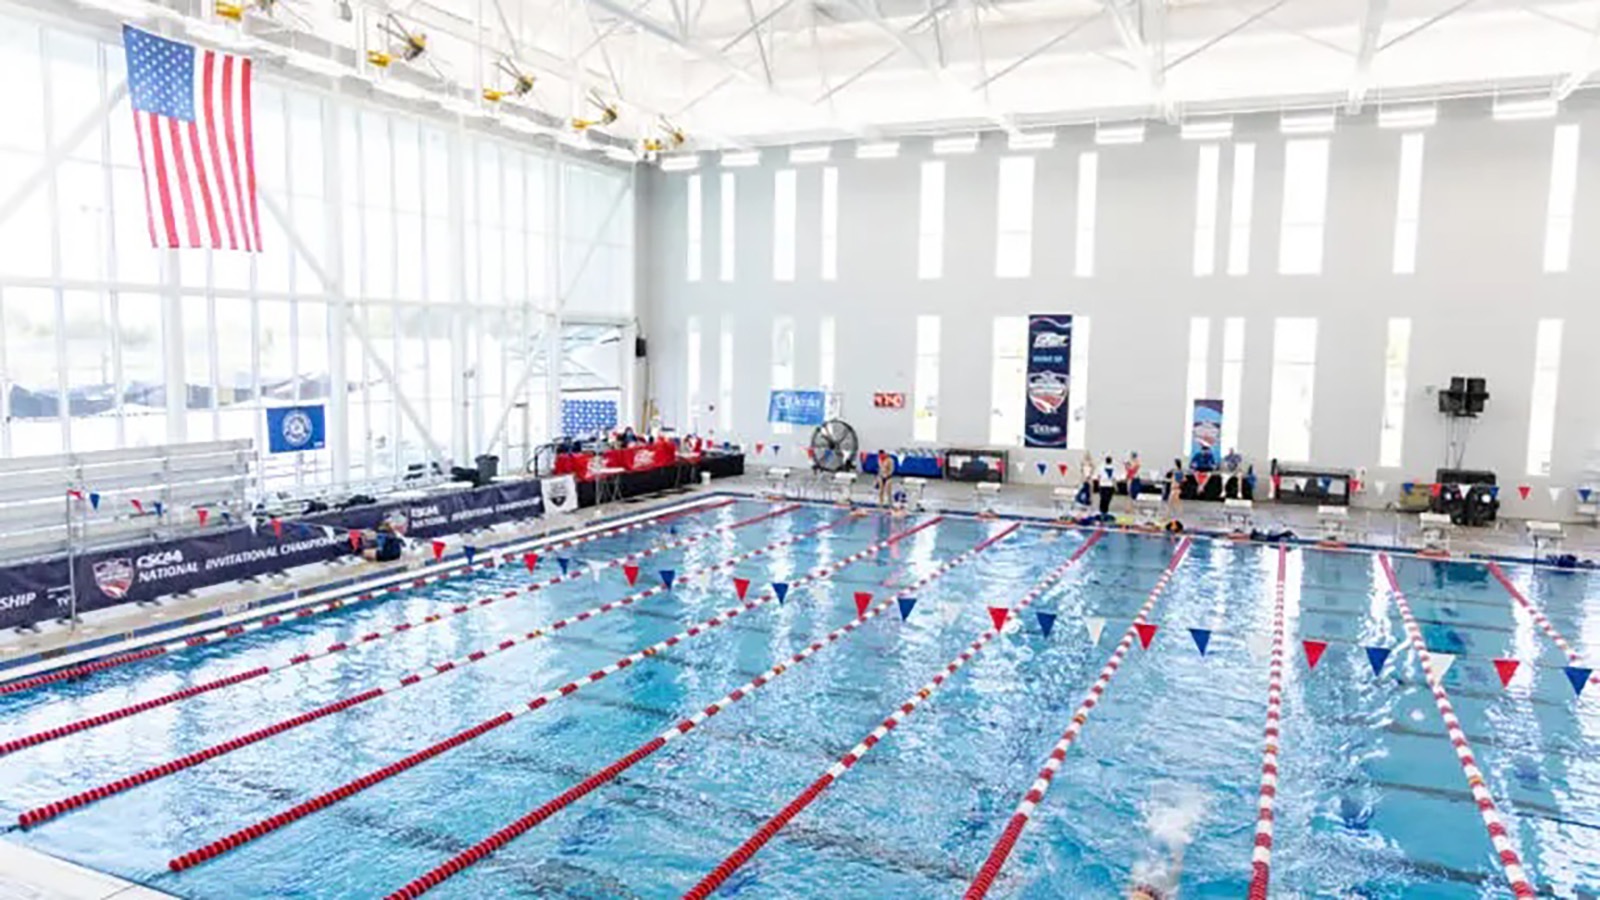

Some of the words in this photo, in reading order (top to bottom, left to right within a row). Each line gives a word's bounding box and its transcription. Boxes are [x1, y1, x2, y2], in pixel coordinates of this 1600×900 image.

[136, 549, 183, 568] CSCAA
[138, 562, 198, 582] NATIONAL
[205, 547, 277, 570] INVITATIONAL
